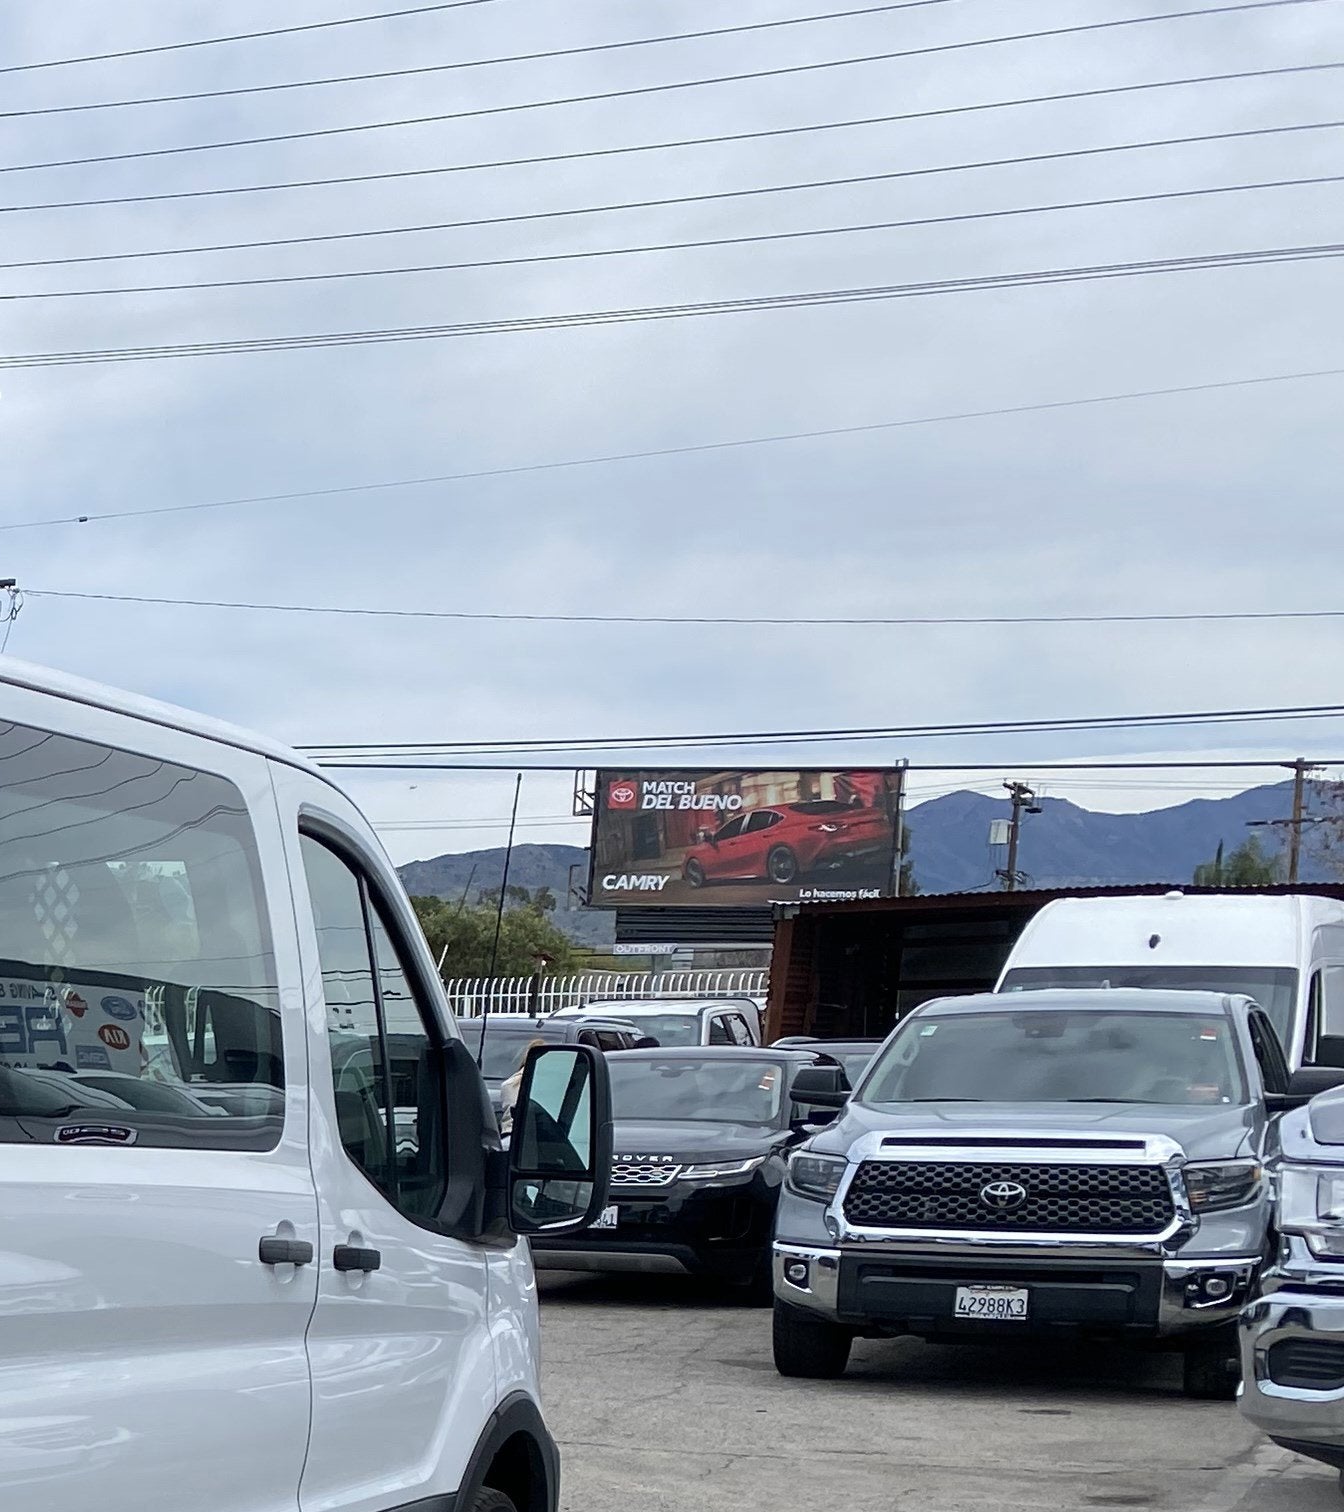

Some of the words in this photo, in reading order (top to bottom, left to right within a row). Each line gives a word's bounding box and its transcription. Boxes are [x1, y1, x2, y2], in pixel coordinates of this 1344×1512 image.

[642, 781, 696, 794] MATCH
[642, 794, 675, 810] DEL
[677, 794, 743, 811] BUENO
[602, 874, 670, 891] CAMRY
[799, 888, 812, 898] Lo
[813, 888, 857, 898] hacemos
[958, 1296, 1025, 1315] 42988K3
